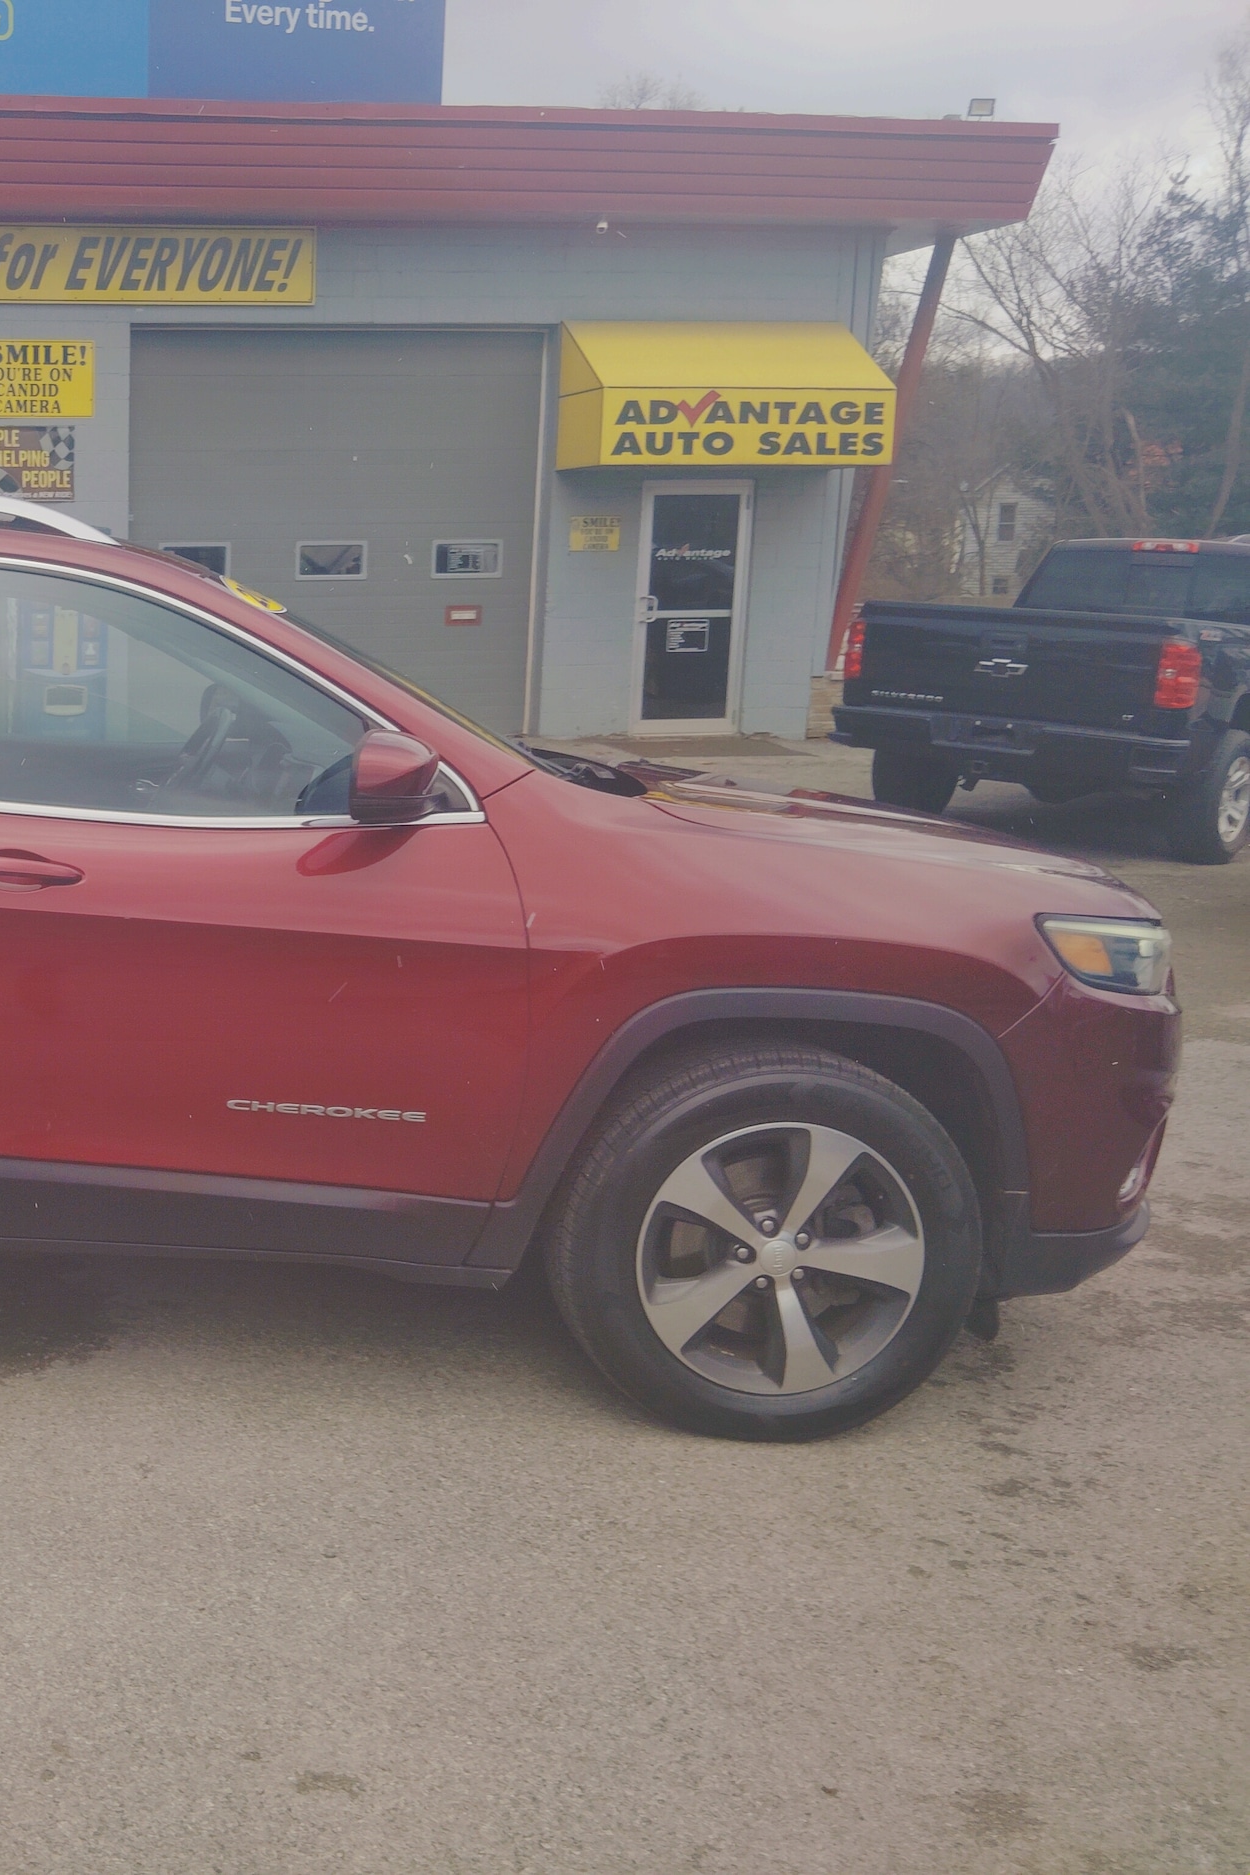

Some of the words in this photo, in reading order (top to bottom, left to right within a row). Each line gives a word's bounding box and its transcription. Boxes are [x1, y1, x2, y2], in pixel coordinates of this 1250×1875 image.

[225, 0, 301, 34] Every
[306, 2, 375, 32] time.
[64, 236, 303, 293] EVERYONE!
[50, 367, 73, 382] ON
[615, 390, 886, 428] ADVANTAGE
[610, 431, 734, 456] AUTO
[757, 431, 884, 456] SALES
[21, 470, 71, 488] PEOPLE
[226, 1099, 427, 1122] CHEROKEE
